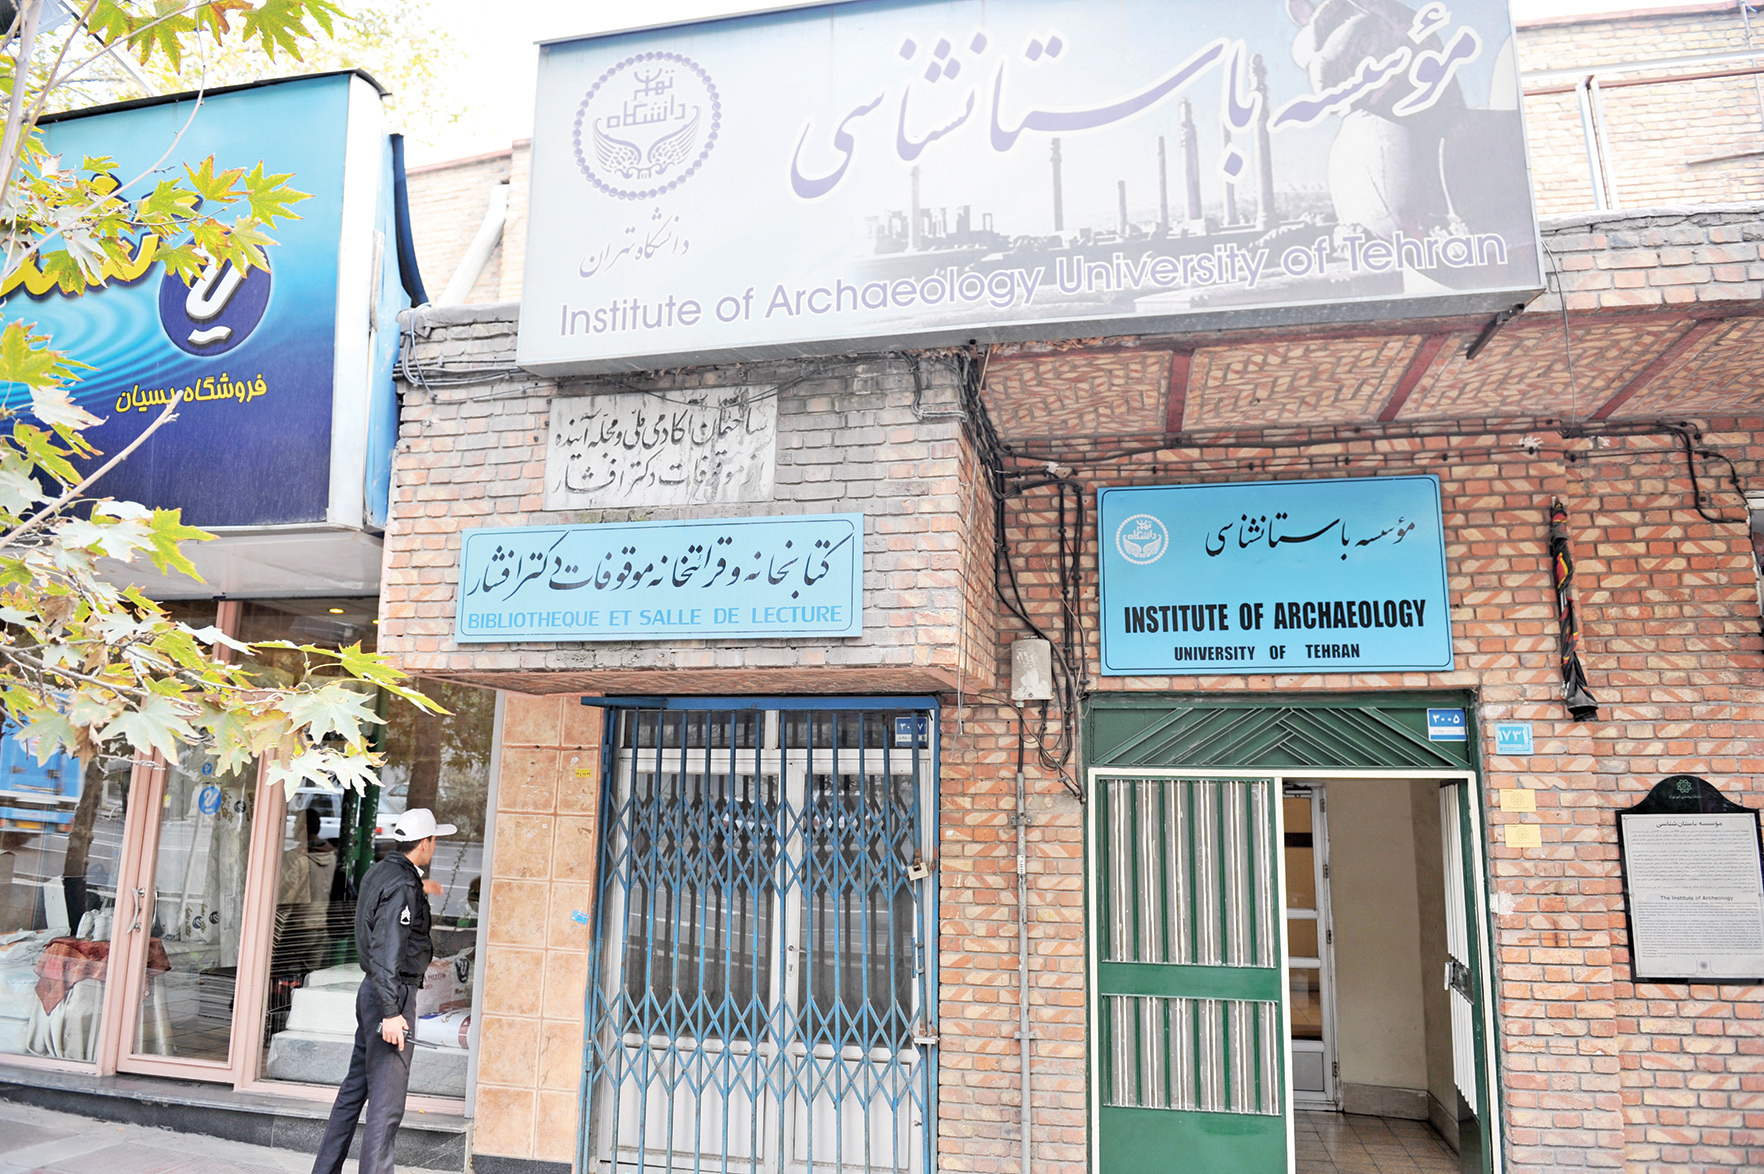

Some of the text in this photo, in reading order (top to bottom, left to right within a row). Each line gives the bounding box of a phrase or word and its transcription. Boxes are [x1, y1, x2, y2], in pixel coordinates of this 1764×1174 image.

[579, 206, 689, 278] دانشگاه تهران
[560, 230, 1508, 337] Institute of Archaeology University of Tehran
[183, 372, 268, 403] فروشگاه
[552, 457, 625, 494] افشار
[623, 446, 664, 498] دکتر
[466, 545, 523, 597] افشار
[502, 530, 572, 602] دکتر
[549, 546, 654, 591] موقوفات
[726, 566, 741, 587] و
[743, 532, 854, 600] کتابخانه
[468, 604, 843, 629] BIBLIOTHEQUE ET SALLE DE LECTURE
[1124, 599, 1426, 633] INSTITUTE OF ARCHAEOLOGY
[1174, 643, 1361, 661] UNIVERSITY OF TEHRAN
[900, 722, 924, 731] ۳۰۷
[1432, 714, 1461, 724] ۳۰۰۵
